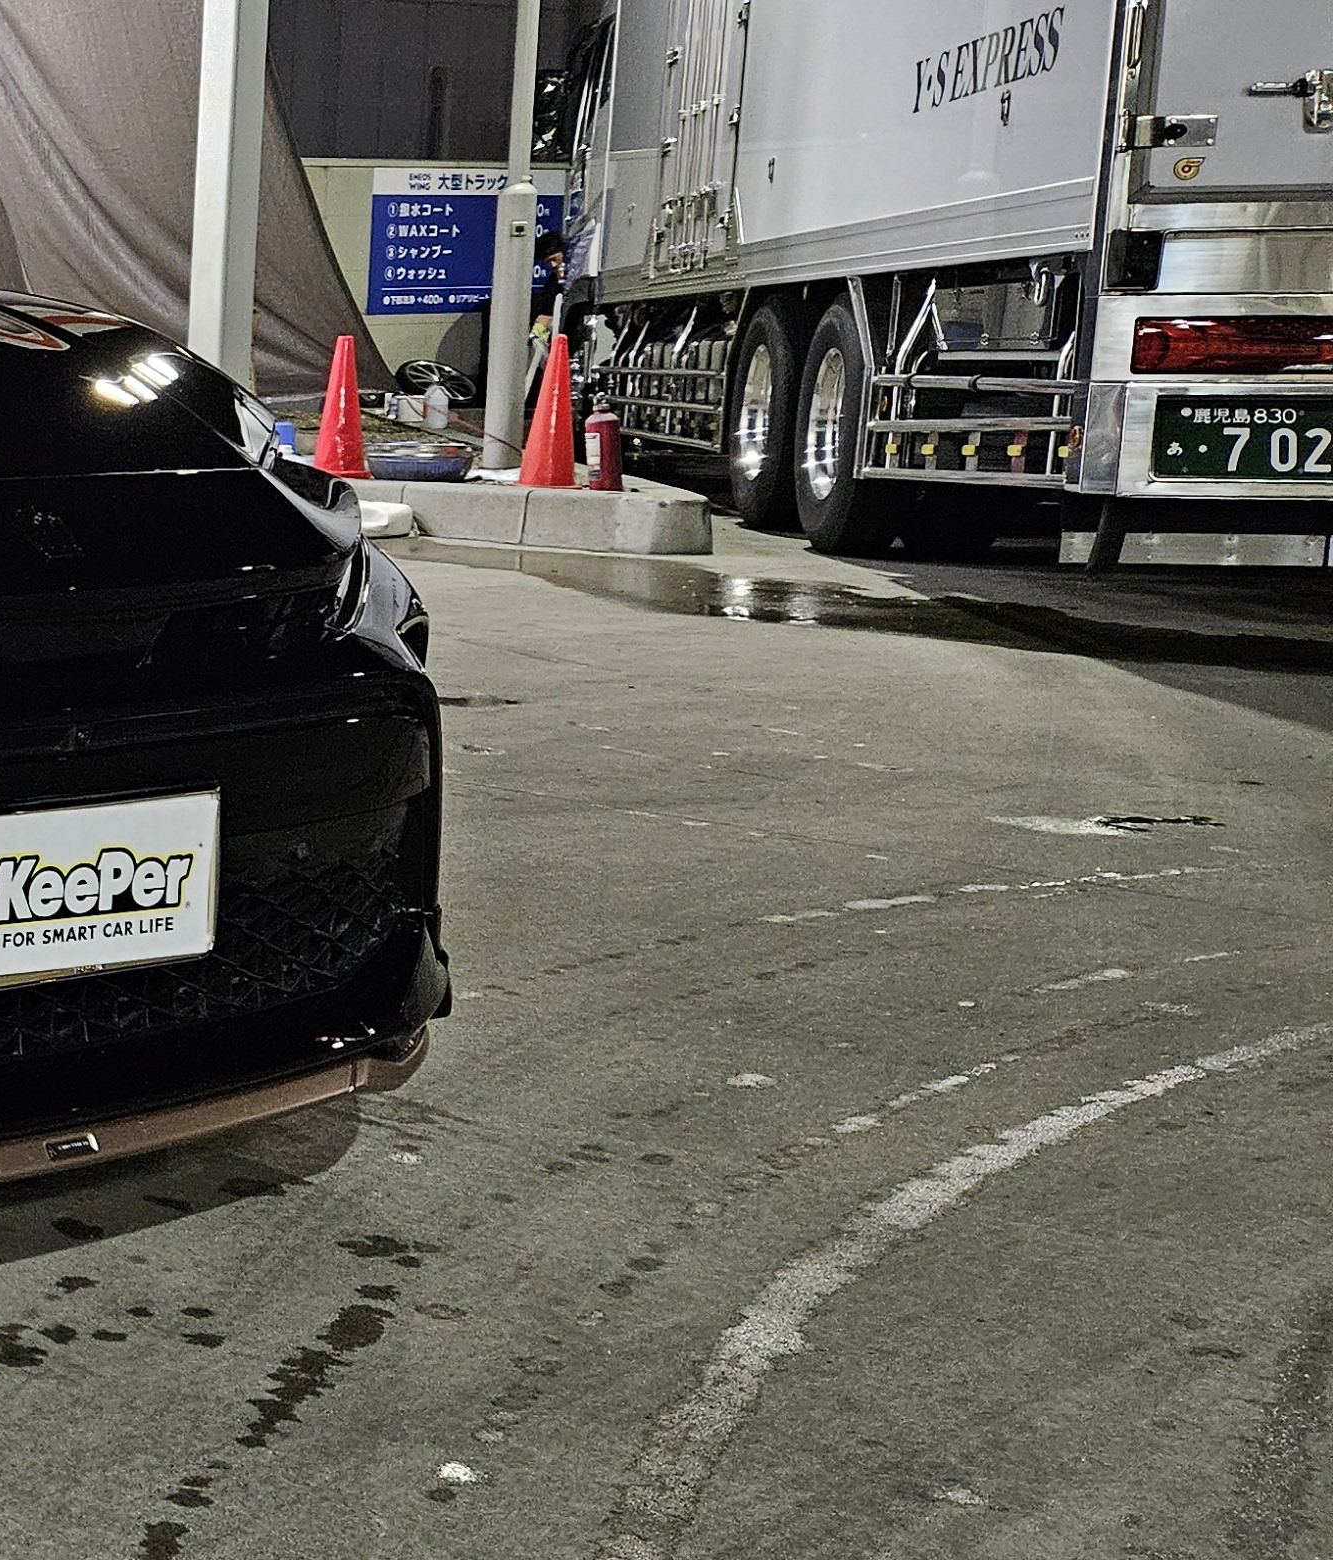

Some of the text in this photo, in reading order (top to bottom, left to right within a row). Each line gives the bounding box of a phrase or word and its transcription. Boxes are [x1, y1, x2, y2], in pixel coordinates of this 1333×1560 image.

[949, 5, 1065, 102] EXPRESS
[409, 173, 432, 181] ENEOS
[438, 173, 533, 190] 大型トラック
[409, 182, 432, 190] WING
[2, 917, 174, 948] FOR SMART CAR LIFE
